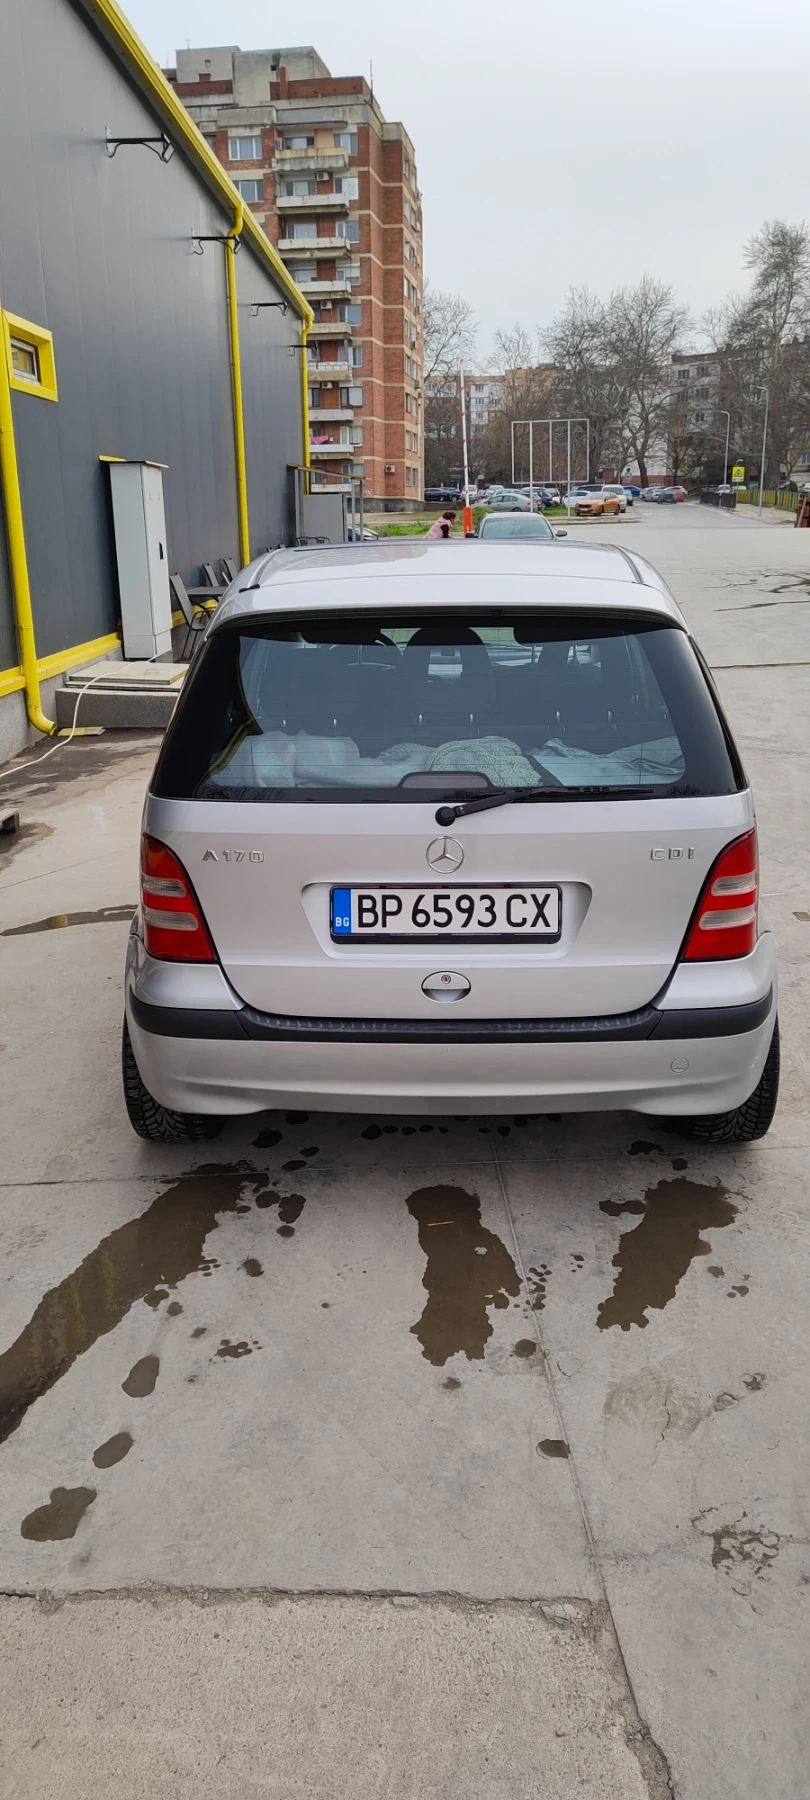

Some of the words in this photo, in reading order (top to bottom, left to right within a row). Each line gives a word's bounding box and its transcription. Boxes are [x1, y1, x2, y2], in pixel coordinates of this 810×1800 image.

[202, 849, 265, 863] A170
[650, 847, 695, 861] CDI
[357, 894, 402, 928] BP
[411, 894, 497, 928] 6593
[506, 893, 551, 928] CX
[335, 917, 350, 927] BG
